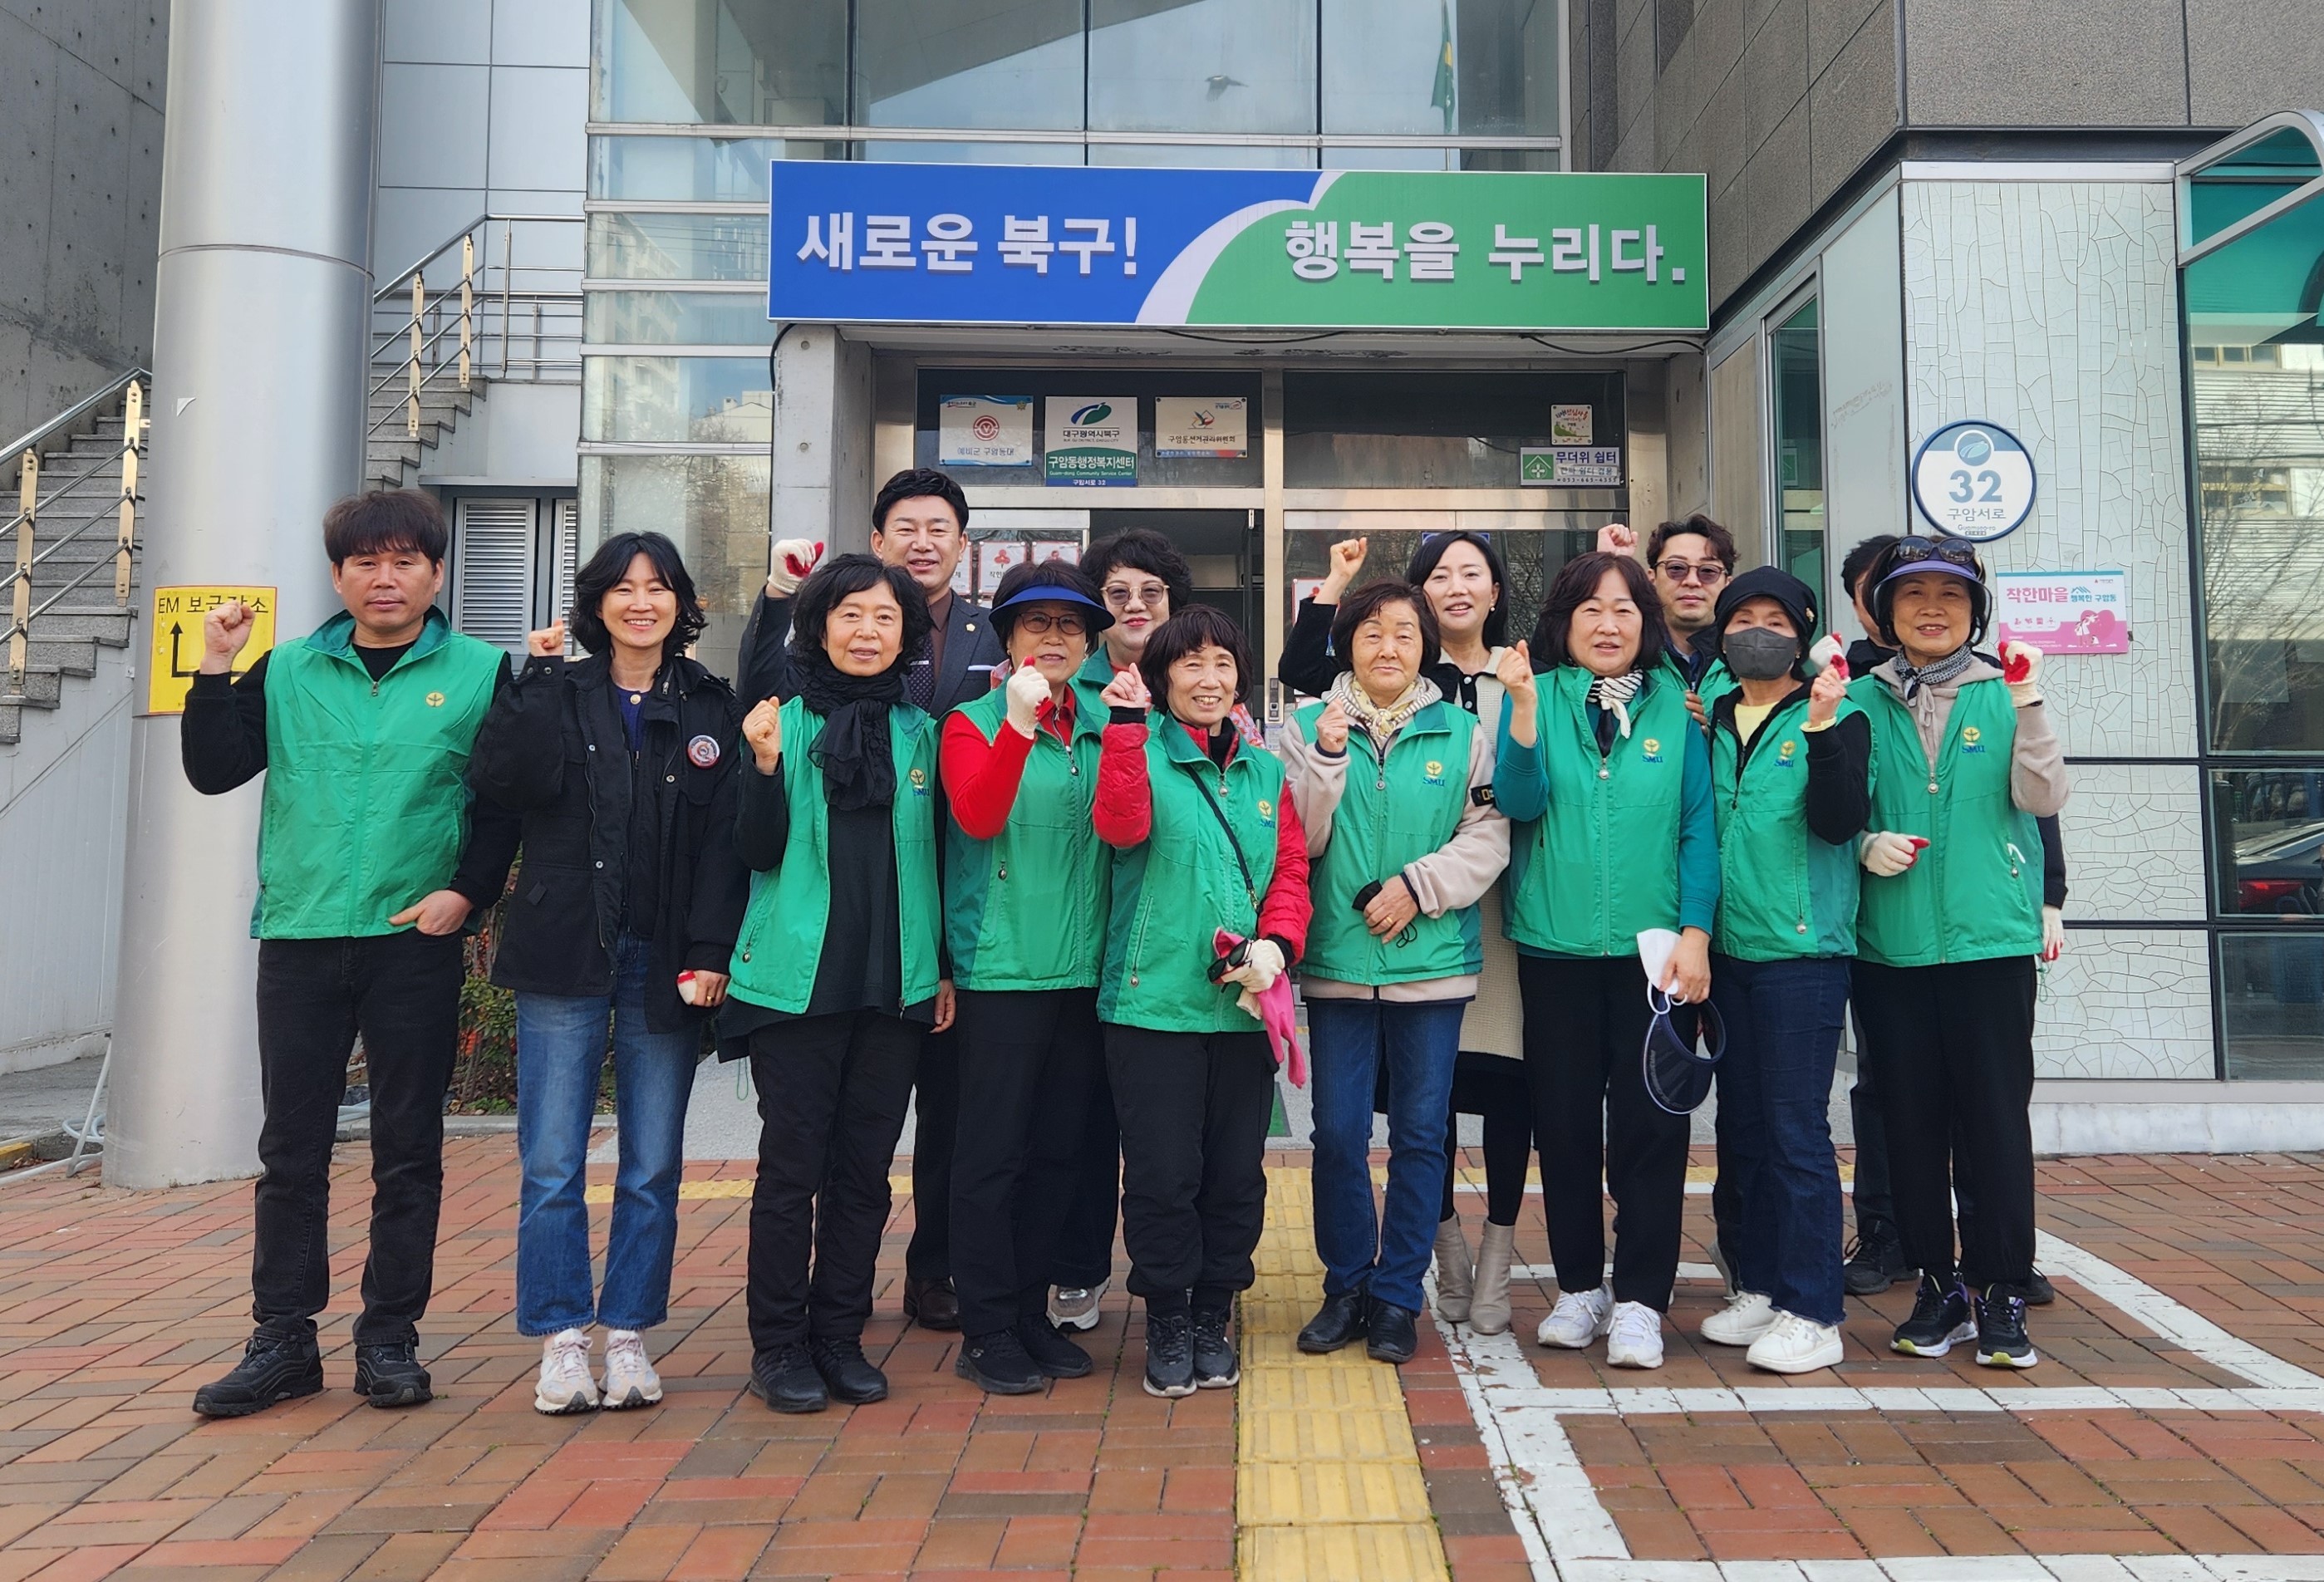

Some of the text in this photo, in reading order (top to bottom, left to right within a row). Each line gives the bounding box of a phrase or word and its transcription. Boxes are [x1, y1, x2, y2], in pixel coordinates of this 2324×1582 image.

[796, 212, 1685, 282] 새로운 북구! 행복을 누리다.
[1063, 430, 1120, 439] 대구광역시북구
[1167, 435, 1236, 445] 구암동선거관리위원회
[1048, 455, 1134, 469] 구암동행정복지센터
[1555, 451, 1616, 464] 무더위 쉼터
[1948, 469, 2002, 504] 32
[1947, 508, 2007, 522] 구암서로
[2006, 587, 2068, 603] 착한마을
[2094, 594, 2117, 602] 구암동
[158, 596, 179, 614] EM
[1422, 775, 1445, 788] SMU
